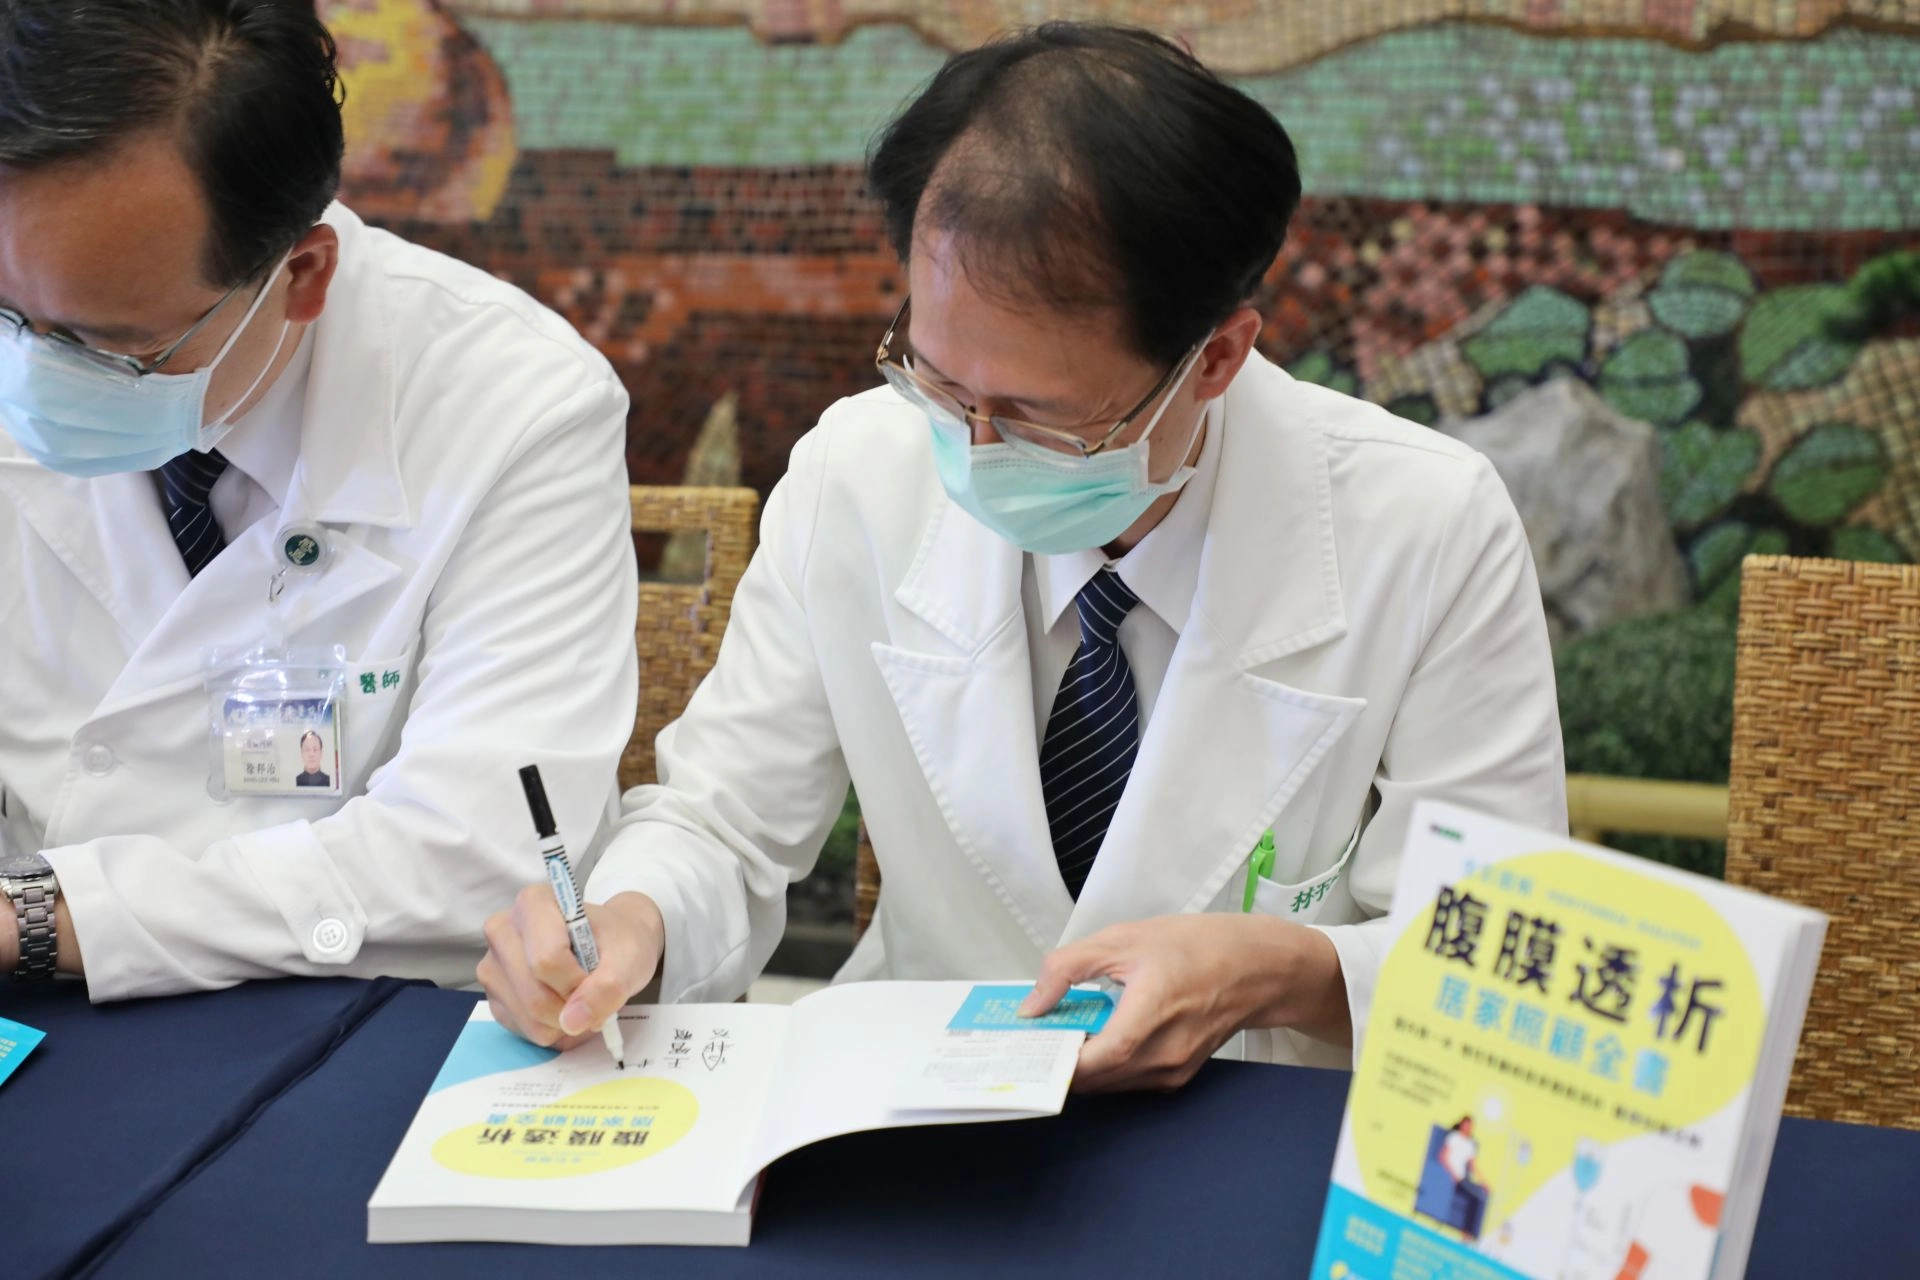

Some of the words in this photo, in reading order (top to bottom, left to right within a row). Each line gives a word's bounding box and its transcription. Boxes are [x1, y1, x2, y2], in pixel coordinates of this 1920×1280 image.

[360, 670, 400, 694] 醫師
[1424, 884, 1723, 1056] 腹膜透析
[1435, 973, 1671, 1099] 居家照顧全書
[477, 1128, 650, 1146] 腹膜透析
